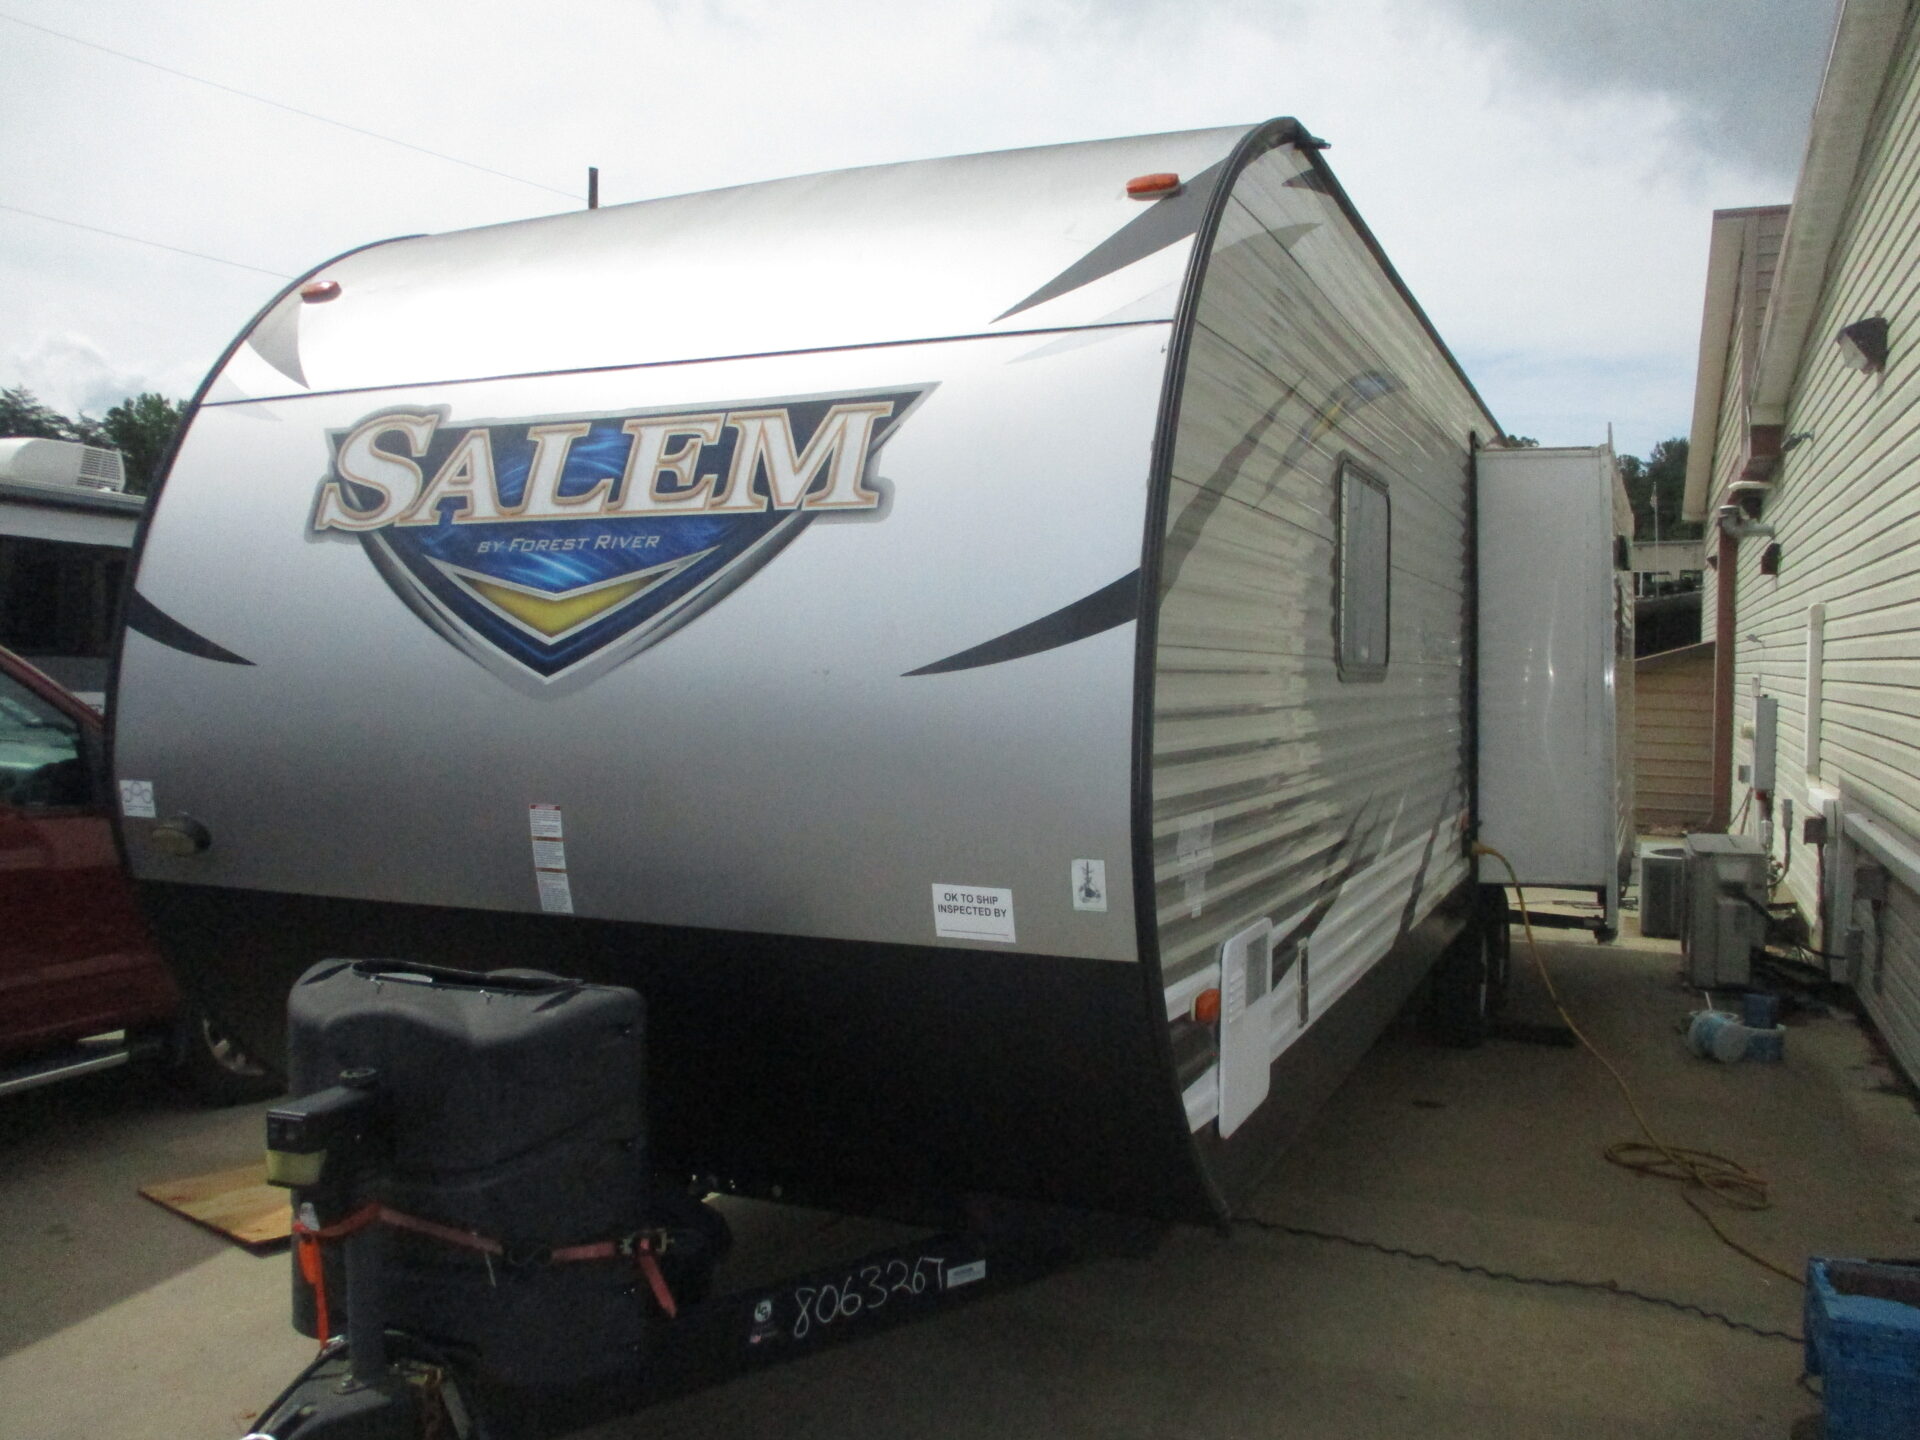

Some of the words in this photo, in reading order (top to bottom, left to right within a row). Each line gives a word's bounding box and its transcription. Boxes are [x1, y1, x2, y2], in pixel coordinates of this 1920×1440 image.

[314, 401, 895, 531] SALEM
[508, 537, 590, 553] FOREST
[594, 534, 661, 550] RIVER
[943, 892, 958, 903] OK
[960, 893, 974, 904] TO
[976, 894, 999, 905] SHIP
[937, 904, 991, 917] INSPECTED
[993, 907, 1007, 918] BY
